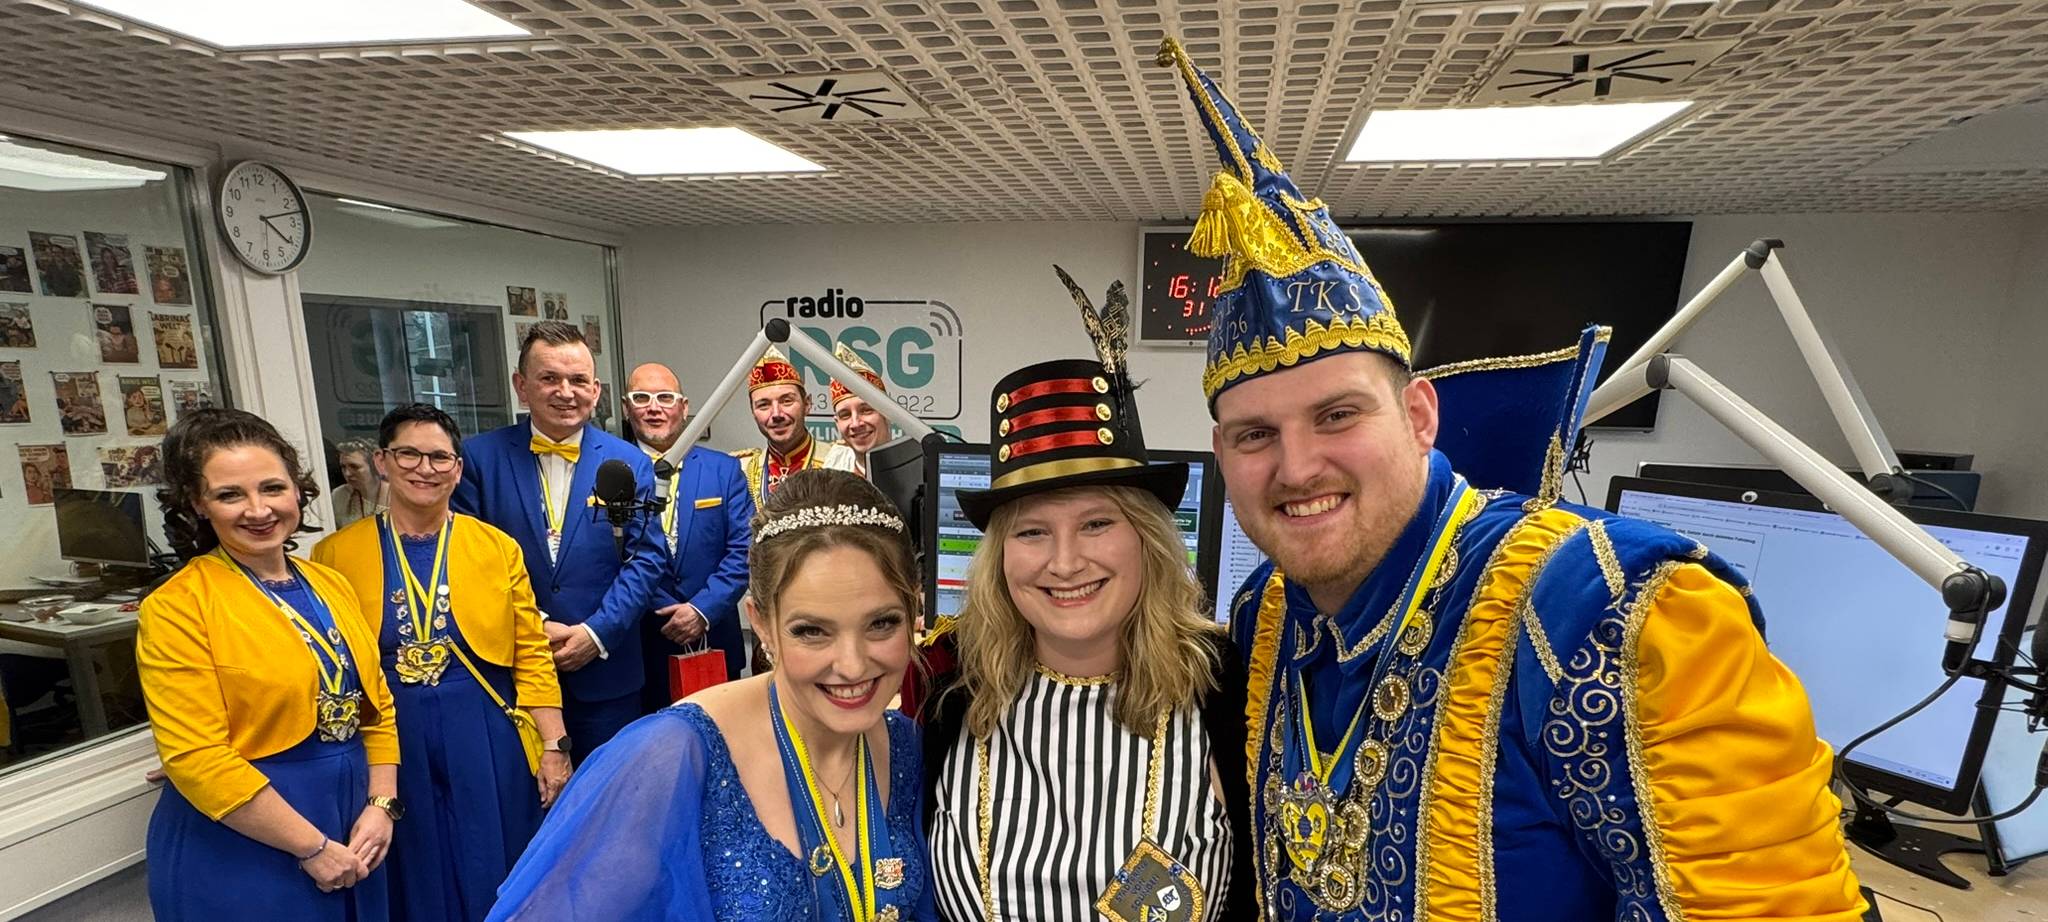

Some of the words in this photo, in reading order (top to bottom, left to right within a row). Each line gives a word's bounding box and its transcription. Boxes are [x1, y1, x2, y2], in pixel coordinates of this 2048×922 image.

[240, 176, 249, 189] 11
[253, 174, 264, 186] 12
[229, 188, 241, 200] 10
[272, 183, 277, 194] 1
[283, 198, 290, 209] 2
[226, 206, 233, 217] 9
[290, 216, 296, 228] 3
[233, 226, 240, 238] 8
[287, 235, 294, 246] 4
[246, 241, 253, 253] 7
[278, 246, 285, 257] 5
[262, 249, 270, 260] 6
[1287, 277, 1362, 316] TKS
[787, 289, 863, 318] radio
[897, 394, 935, 414] 92,2
